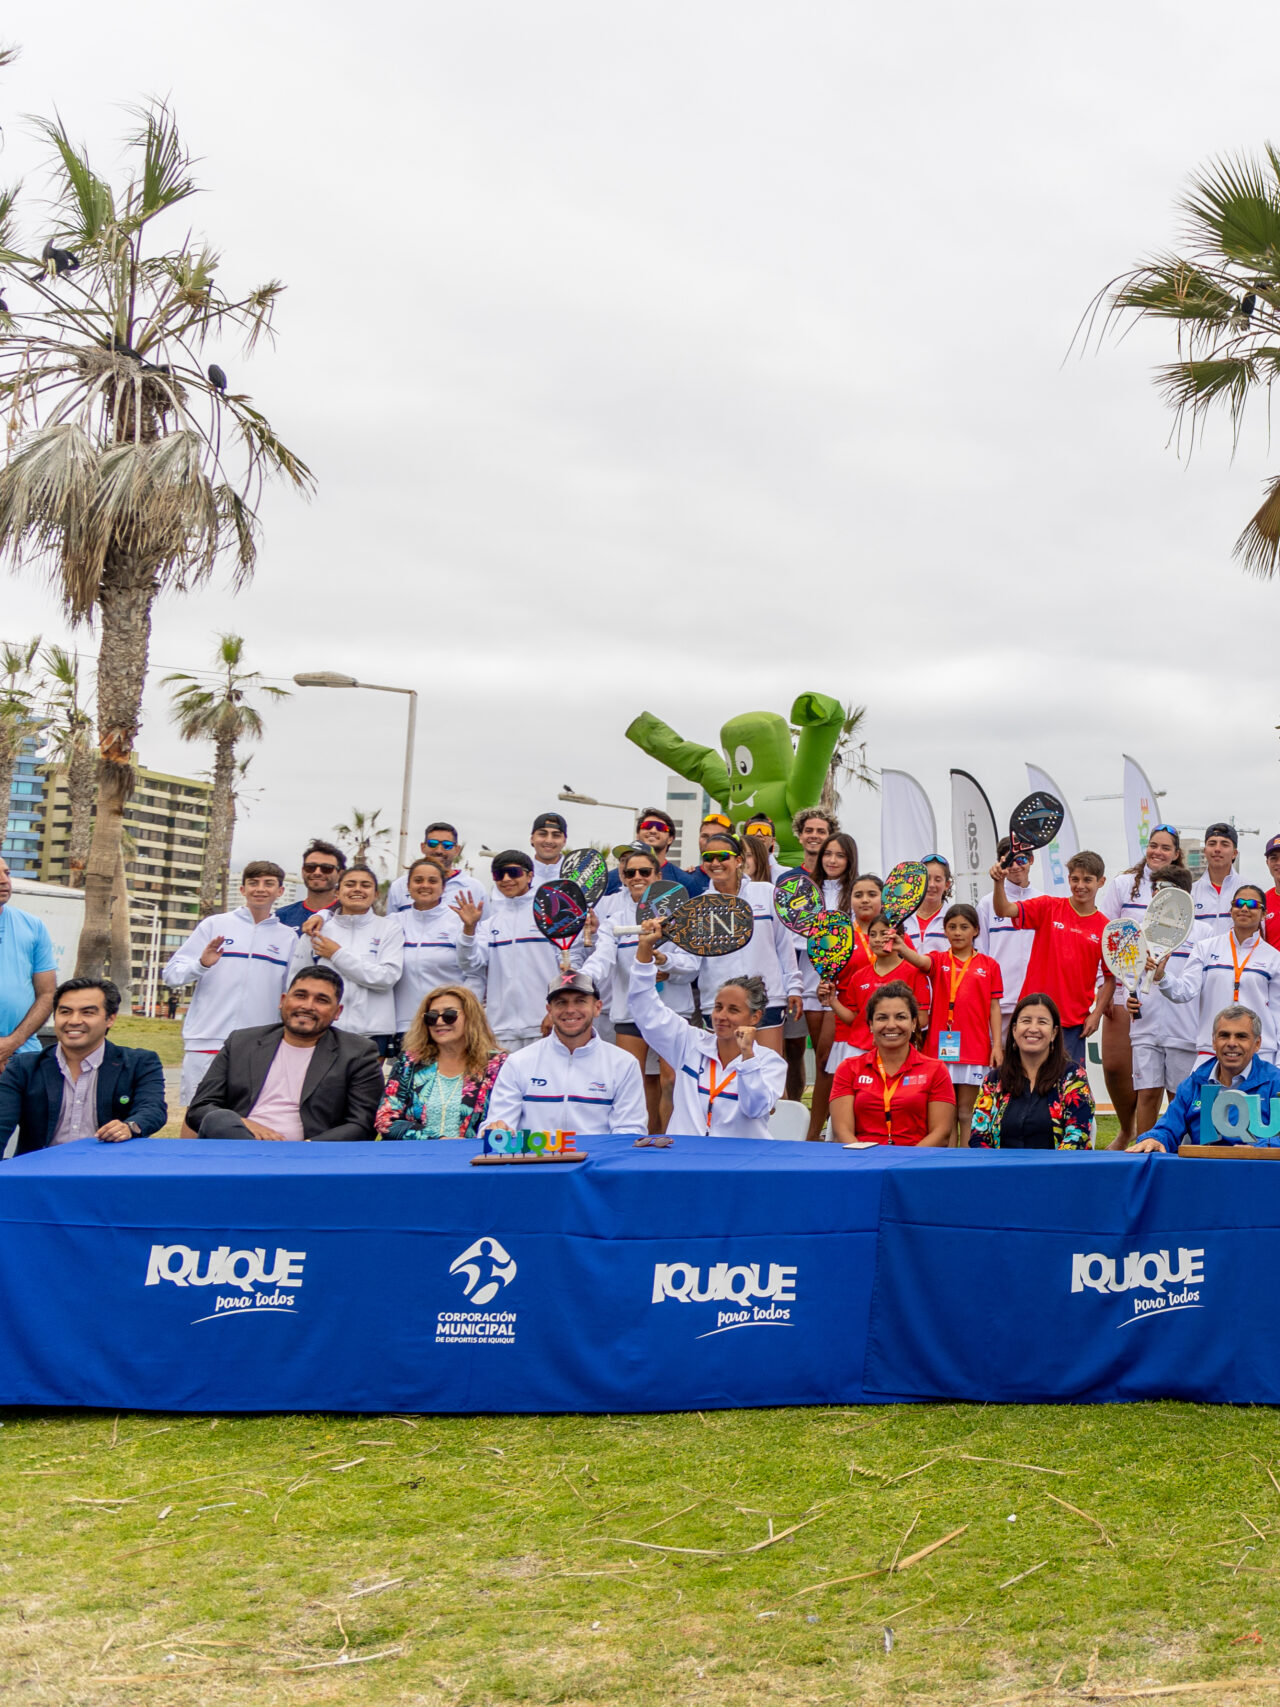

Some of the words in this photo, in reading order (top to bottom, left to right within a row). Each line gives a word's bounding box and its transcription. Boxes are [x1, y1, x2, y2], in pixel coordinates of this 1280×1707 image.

[530, 1077, 548, 1087] TD
[483, 1128, 577, 1157] IQUIQUE
[145, 1244, 307, 1292] IQUIQUE
[1070, 1247, 1205, 1293] IQUIQUE
[651, 1262, 798, 1306] IQUIQUE
[214, 1295, 252, 1312] para
[254, 1288, 295, 1307] todos
[1133, 1297, 1167, 1314] para
[1167, 1286, 1200, 1306] todos
[437, 1310, 517, 1322] CORPORACIÓN
[717, 1310, 751, 1327] para
[752, 1302, 791, 1321] todos
[436, 1323, 516, 1336] MUNICIPAL
[445, 1336, 478, 1344] DEPORTES
[478, 1336, 488, 1344] DE
